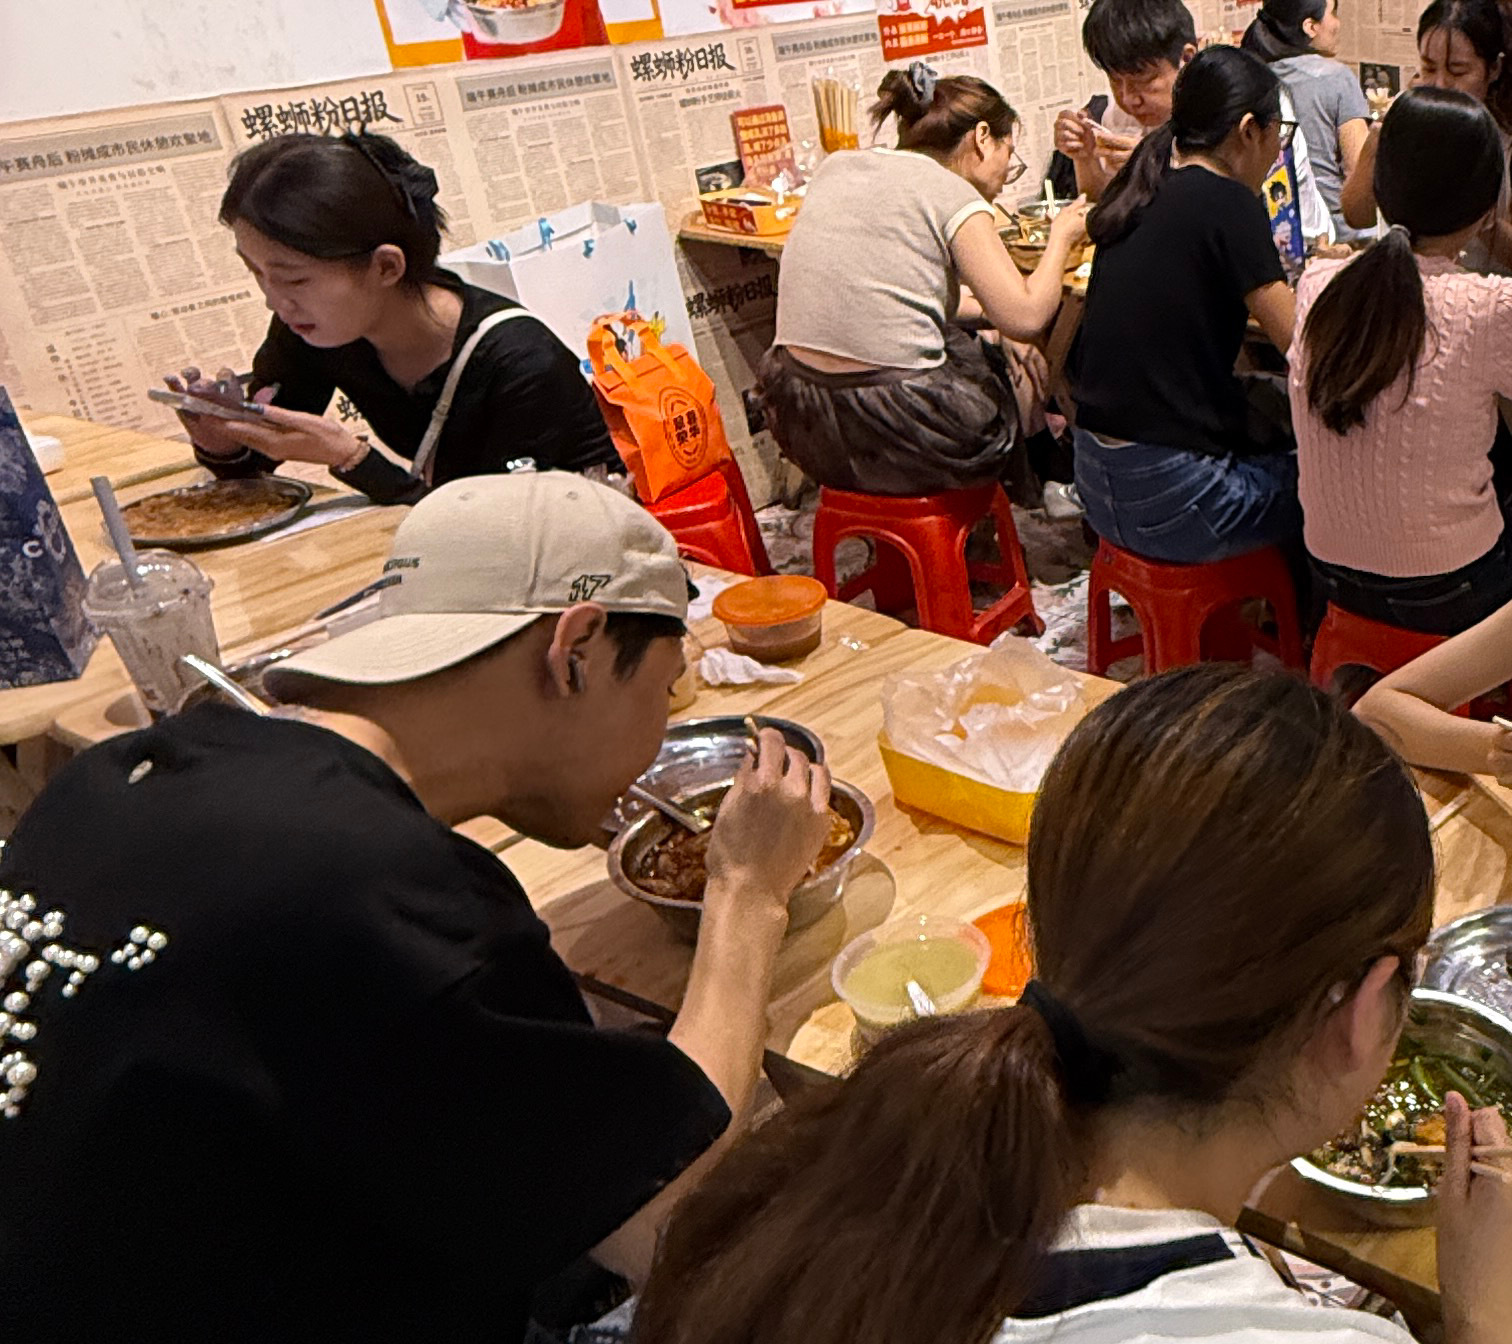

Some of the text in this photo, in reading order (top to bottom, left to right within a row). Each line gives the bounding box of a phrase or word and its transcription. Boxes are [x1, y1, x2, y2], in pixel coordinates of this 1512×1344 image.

[630, 42, 737, 82] 螺蛳粉日报
[241, 89, 403, 142] 螺蛳粉日报
[568, 574, 612, 602] 17
